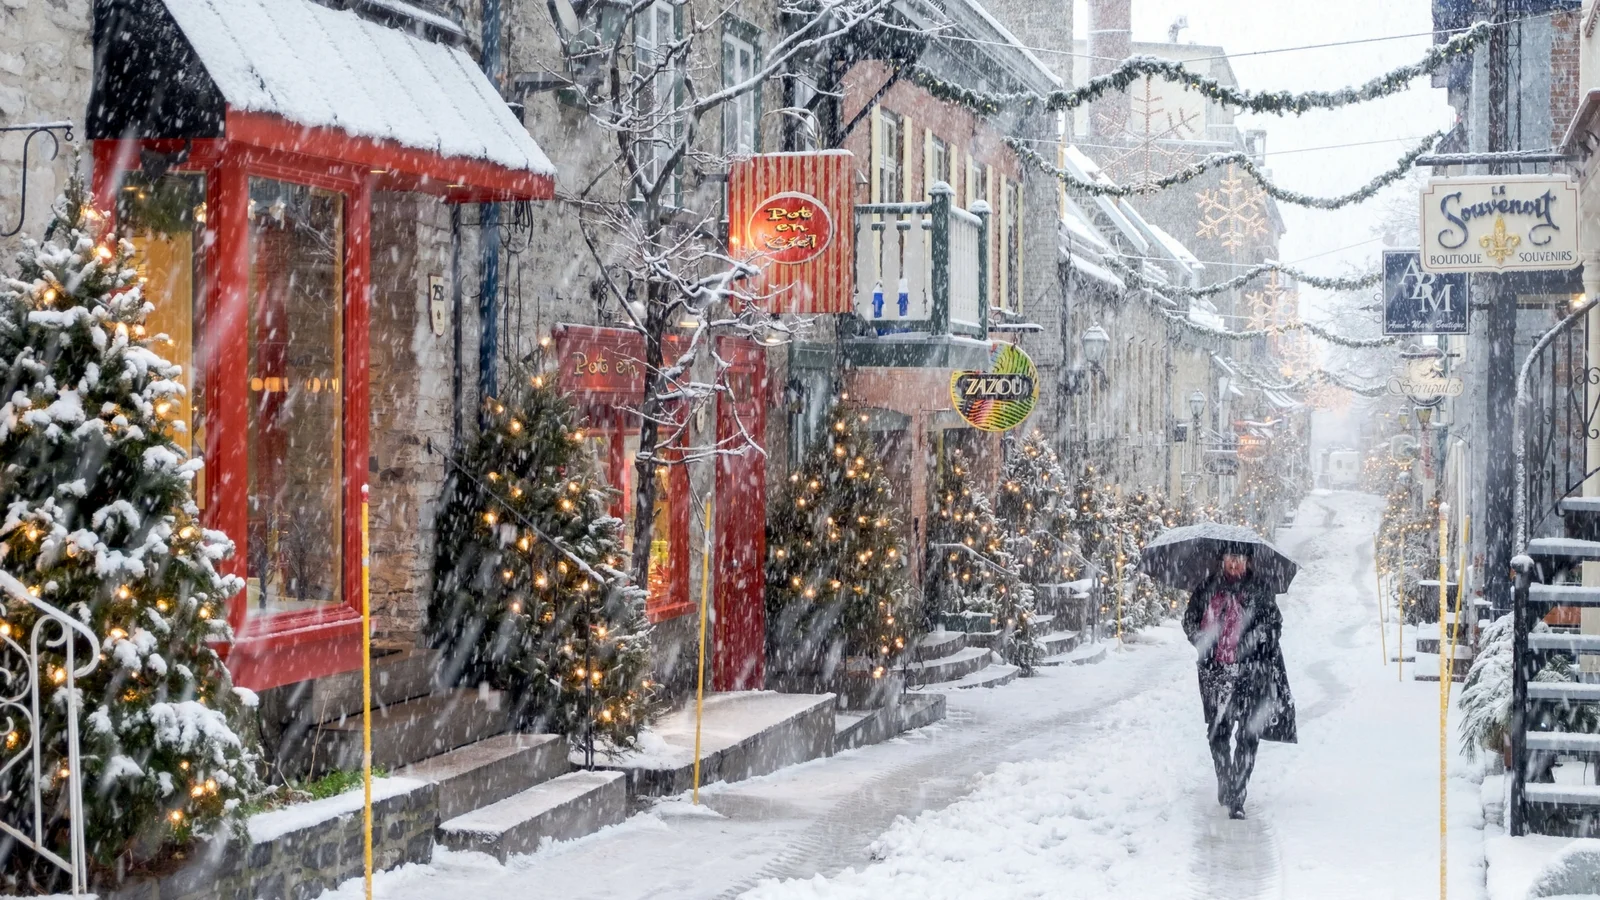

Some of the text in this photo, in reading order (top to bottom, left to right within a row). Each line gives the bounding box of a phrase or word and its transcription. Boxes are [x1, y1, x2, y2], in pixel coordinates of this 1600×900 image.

[1491, 185, 1506, 196] LE
[764, 206, 813, 221] Pot
[775, 223, 809, 232] en
[1430, 250, 1573, 265] BOUTIQUE SOUVENIRS
[1435, 319, 1465, 331] Boutique
[572, 351, 609, 375] Pot
[615, 360, 640, 377] en
[965, 378, 1022, 395] ZAZOU
[1389, 379, 1462, 397] Scrupules
